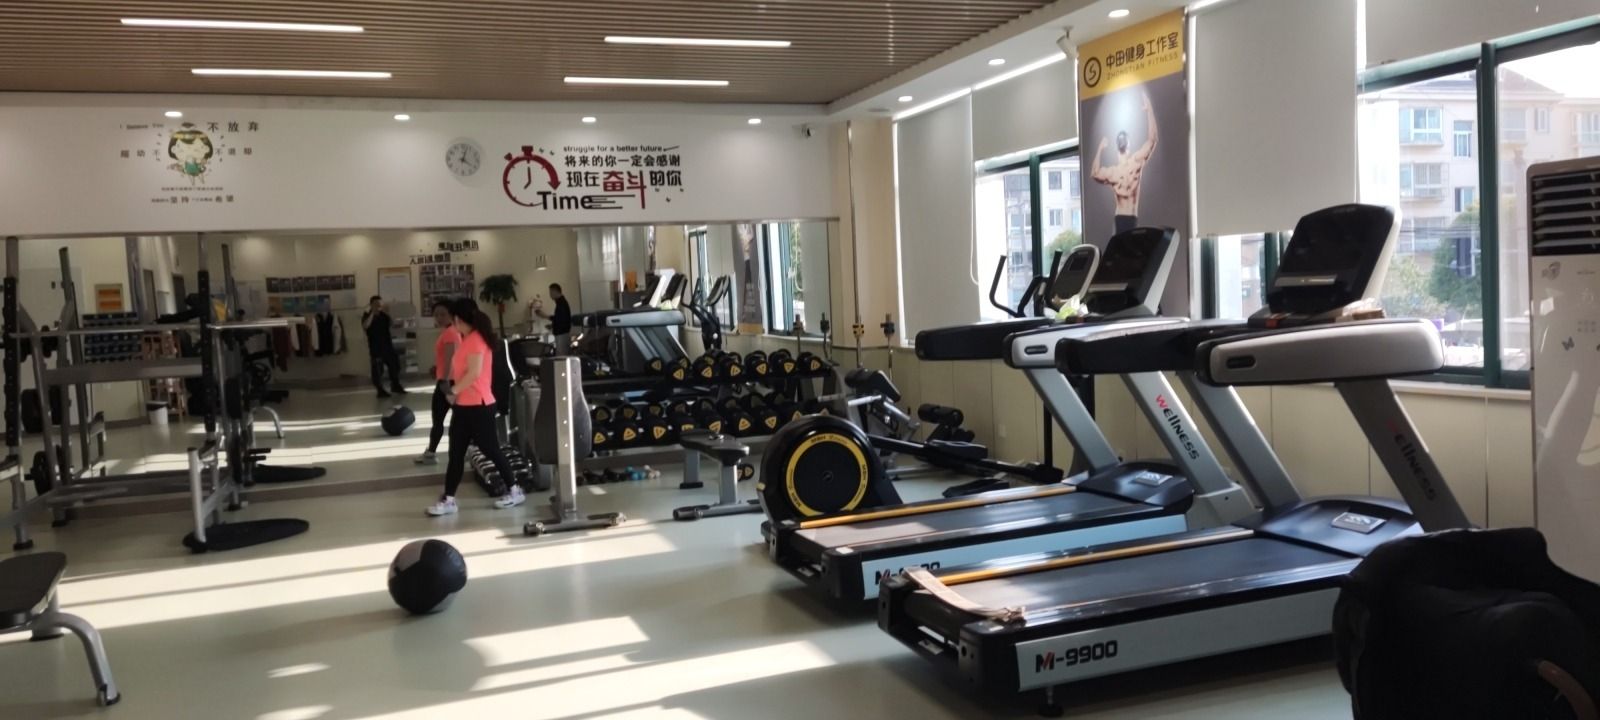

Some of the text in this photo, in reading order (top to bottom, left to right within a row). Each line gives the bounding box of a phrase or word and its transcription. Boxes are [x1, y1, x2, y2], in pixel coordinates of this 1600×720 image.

[1106, 32, 1178, 69] 中田健身工作室
[207, 121, 259, 133] 不放弃
[563, 145, 595, 153] struggle
[640, 144, 663, 152] future
[565, 154, 681, 168] 将来的你一定会感谢
[537, 191, 593, 210] Time
[1035, 640, 1118, 673] M-9900
